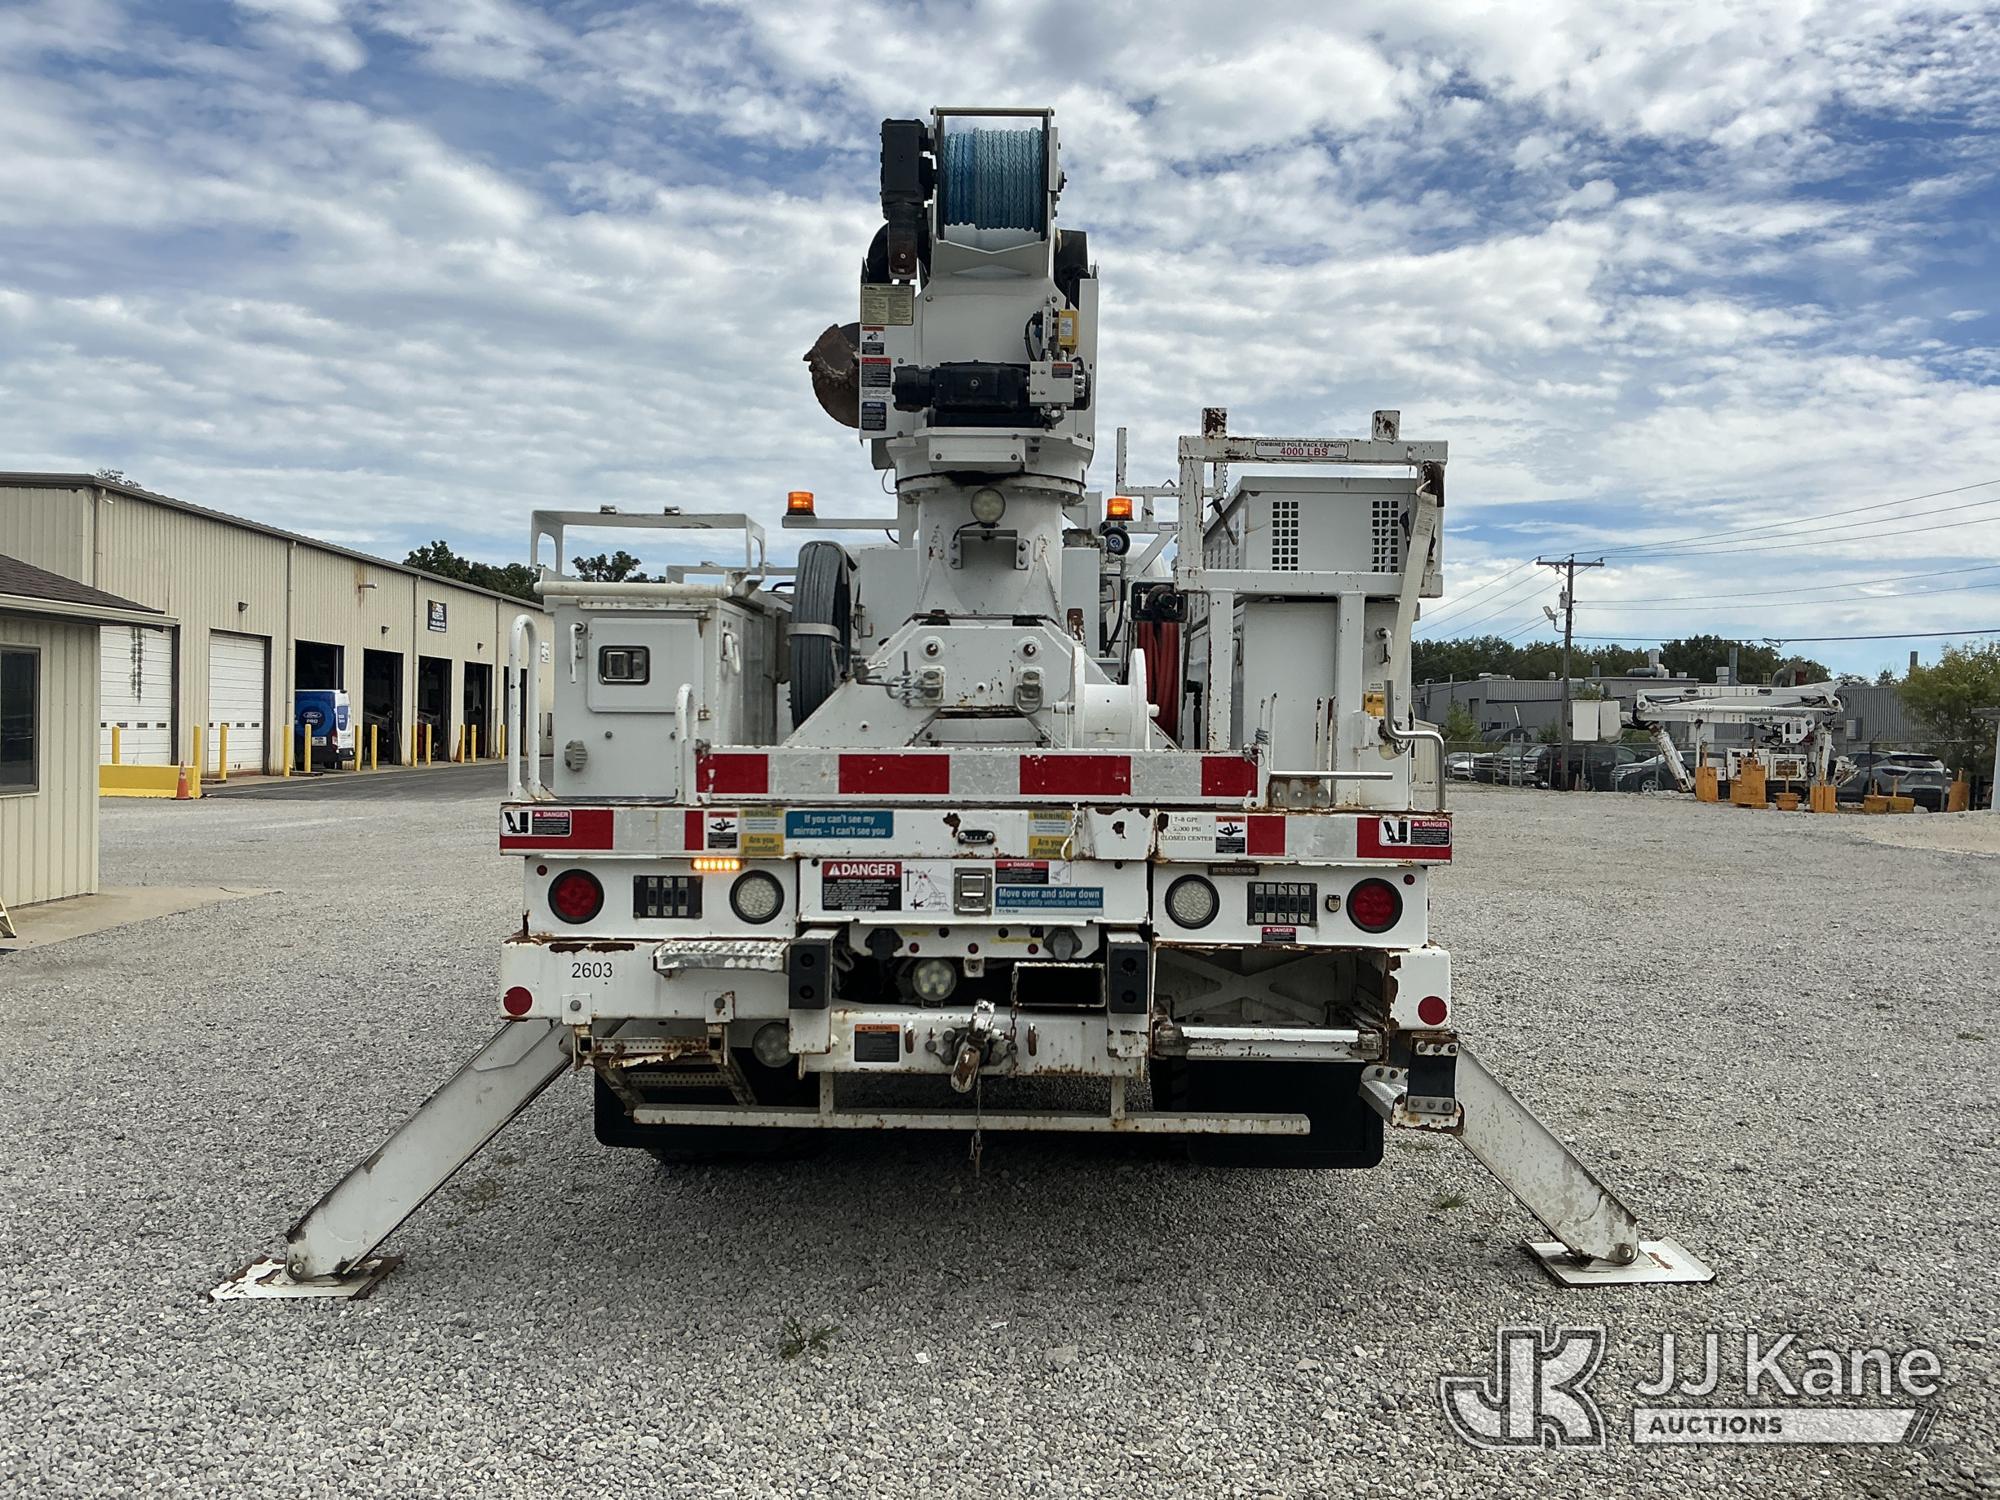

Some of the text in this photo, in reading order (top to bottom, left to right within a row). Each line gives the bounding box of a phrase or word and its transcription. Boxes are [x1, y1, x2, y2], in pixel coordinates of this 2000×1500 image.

[1280, 447, 1329, 456] 4000 LBS
[804, 814, 811, 823] If
[812, 816, 826, 825] you
[827, 814, 847, 823] can't
[863, 816, 875, 825] my
[793, 826, 822, 835] mirrors
[836, 827, 856, 835] can't
[871, 828, 886, 837] you
[841, 863, 896, 876] DANGER
[999, 888, 1020, 897] Move
[1041, 888, 1056, 897] and
[1059, 888, 1077, 897] slow
[1078, 889, 1100, 898] down
[571, 962, 613, 978] 2603
